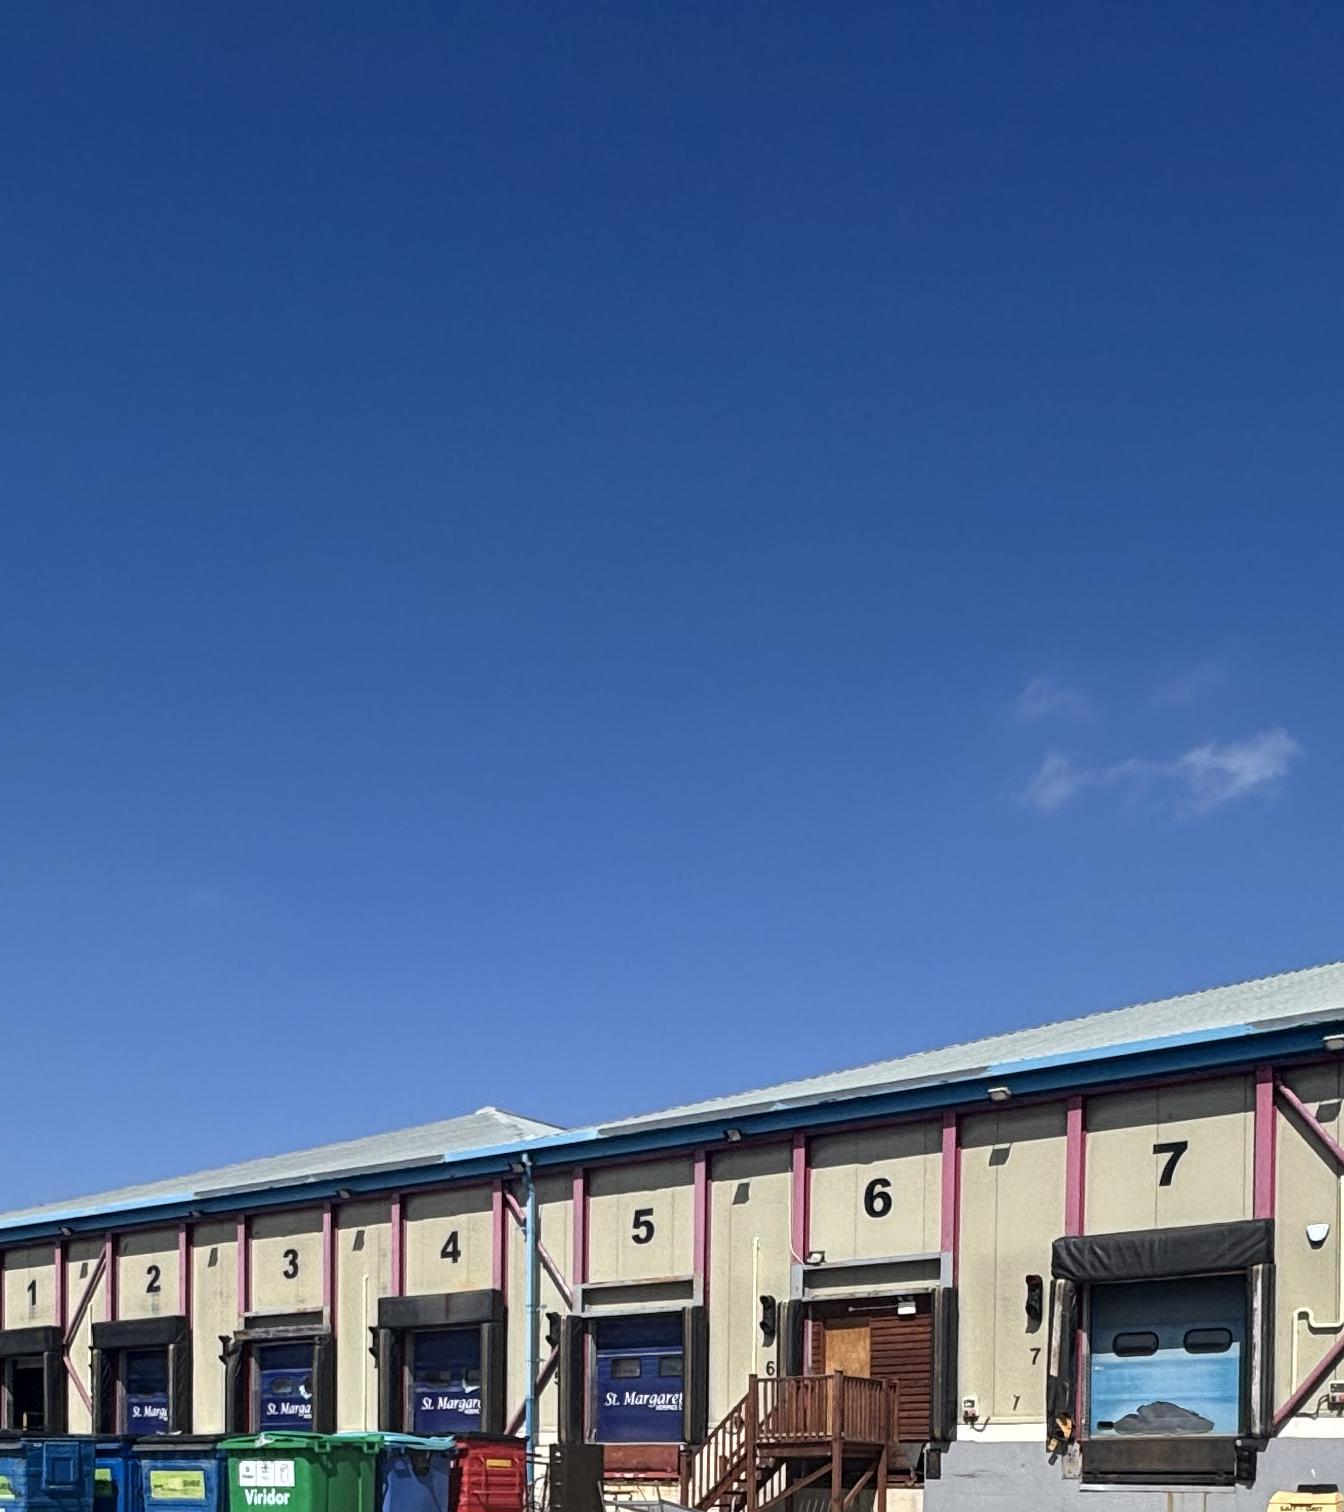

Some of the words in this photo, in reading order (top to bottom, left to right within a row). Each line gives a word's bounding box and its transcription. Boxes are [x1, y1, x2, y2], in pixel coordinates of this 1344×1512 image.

[1152, 1140, 1189, 1187] 7
[864, 1178, 893, 1218] 6
[631, 1207, 655, 1245] 5
[440, 1230, 462, 1264] 4
[282, 1248, 299, 1280] 3
[27, 1279, 37, 1306] 1
[146, 1264, 161, 1294] 2
[766, 1360, 776, 1377] 6
[1029, 1347, 1042, 1366] 7
[420, 1397, 434, 1410] St.
[605, 1392, 620, 1406] St.
[244, 1488, 291, 1506] Viridor
